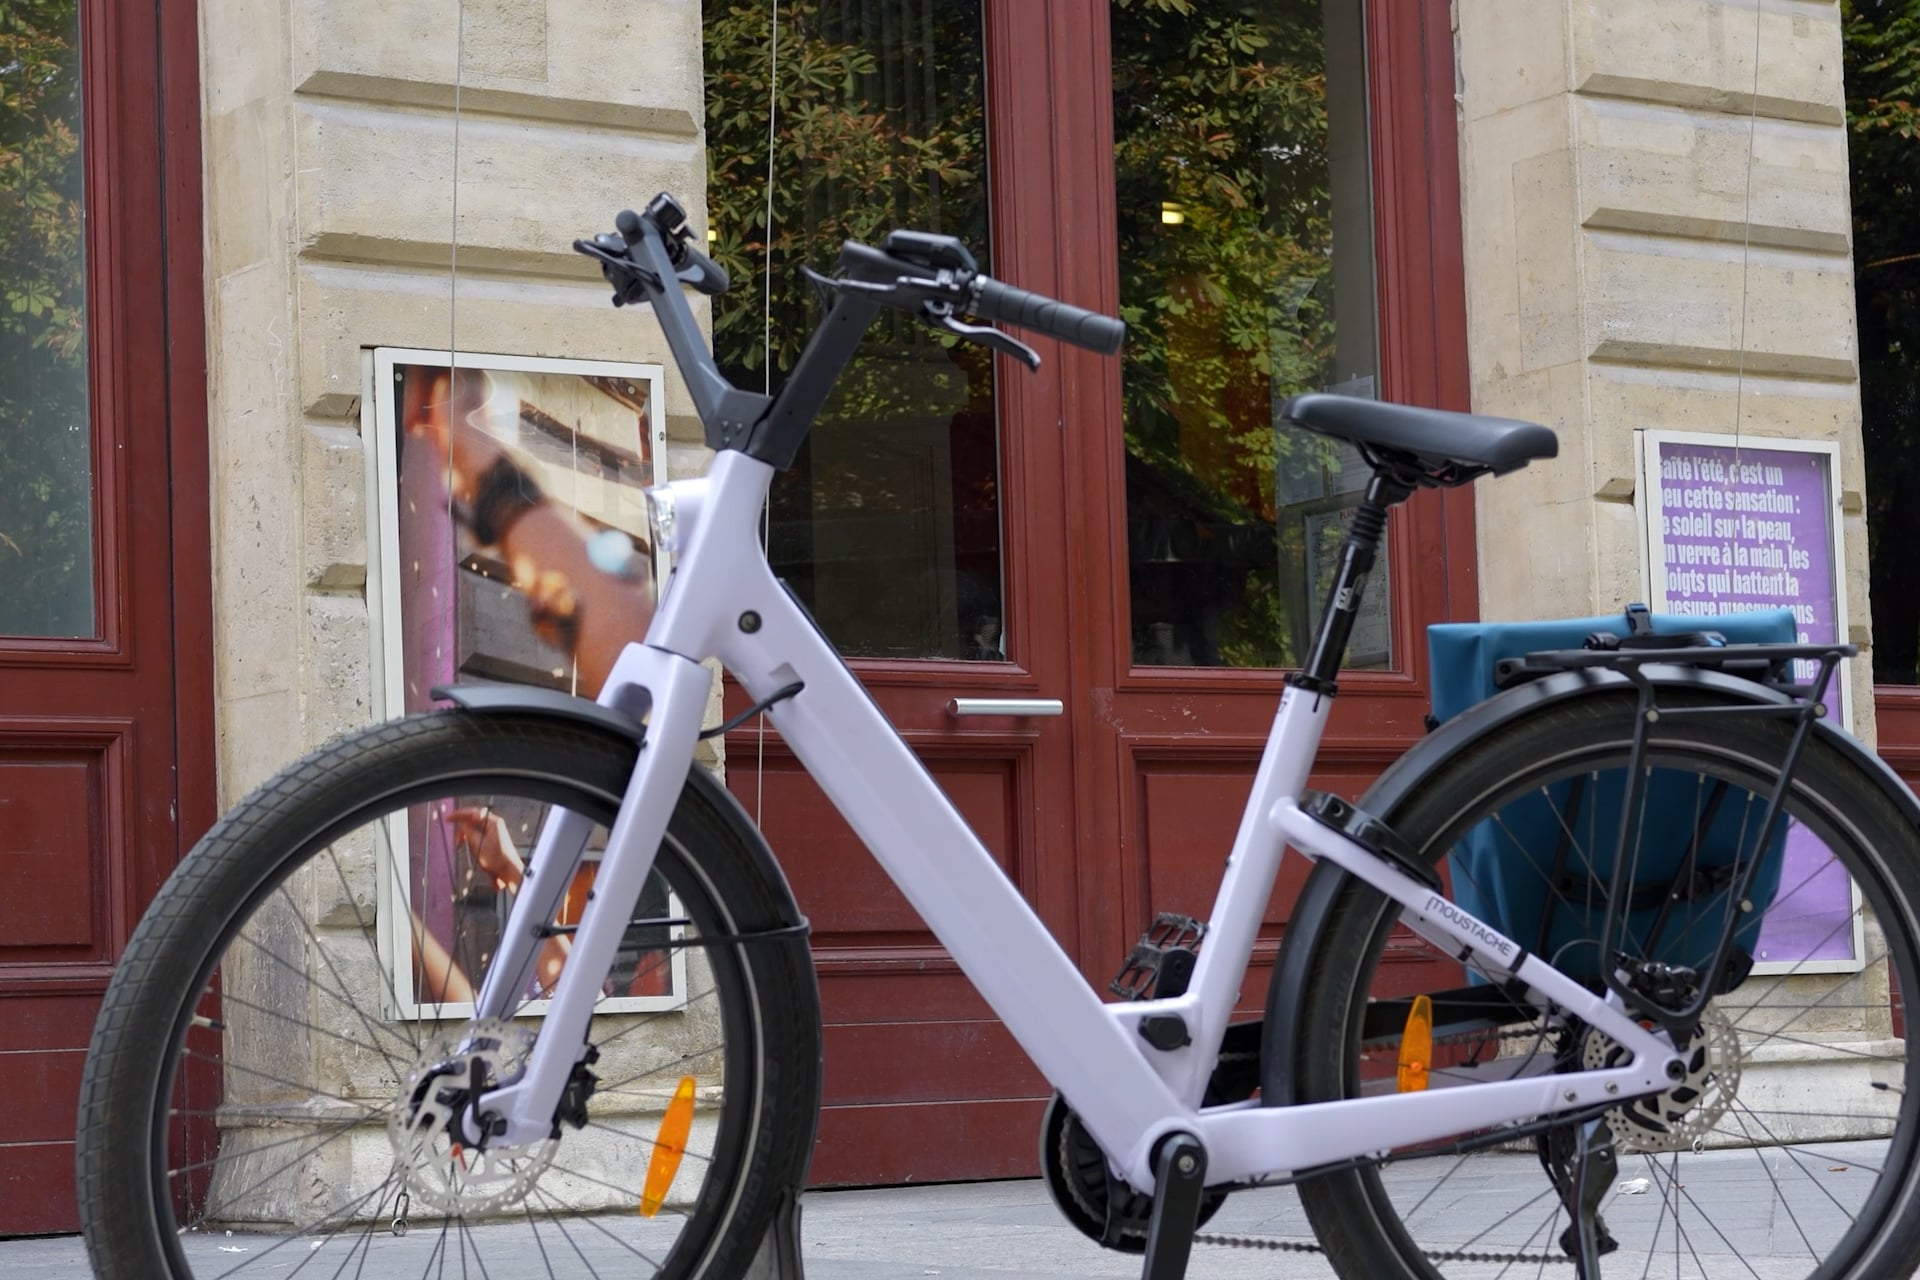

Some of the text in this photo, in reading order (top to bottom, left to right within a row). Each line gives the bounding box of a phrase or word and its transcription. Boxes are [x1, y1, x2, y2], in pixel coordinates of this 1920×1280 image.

[1729, 459, 1764, 485] c'est
[1765, 466, 1783, 486] un
[1661, 487, 1682, 508] eu
[1684, 486, 1723, 510] cette
[1725, 488, 1794, 514] sensation
[1672, 511, 1712, 538] soleil
[1714, 518, 1740, 539] sur
[1741, 514, 1756, 539] la
[1757, 520, 1795, 545] peau,
[1677, 544, 1720, 566] verre
[1722, 541, 1732, 566] à
[1733, 541, 1748, 567] la
[1750, 543, 1787, 571] main,
[1788, 544, 1810, 570] les
[1707, 569, 1731, 598] qui
[1733, 569, 1784, 596] battent
[1785, 571, 1799, 596] la
[1425, 896, 1512, 957] MOUSTACHE
